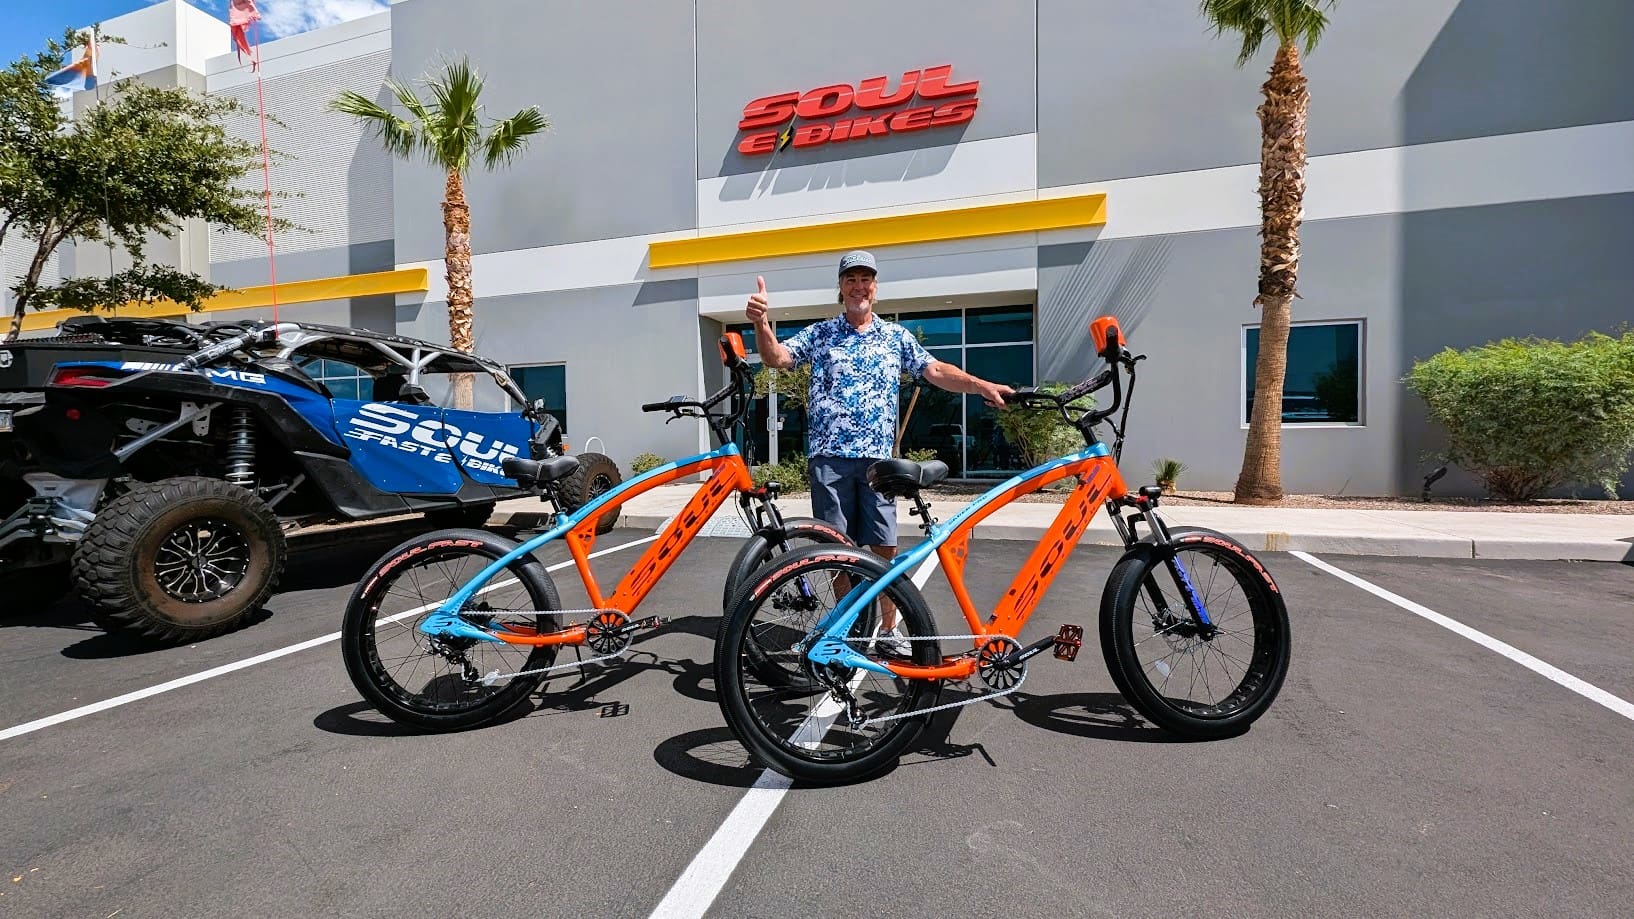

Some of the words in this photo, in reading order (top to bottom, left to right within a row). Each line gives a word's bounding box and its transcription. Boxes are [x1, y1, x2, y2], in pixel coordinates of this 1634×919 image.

[738, 64, 979, 130] SOUL
[792, 98, 979, 149] BIKES
[344, 428, 437, 456] FAST
[630, 471, 737, 597] SOUL
[1013, 473, 1112, 621] SOUL
